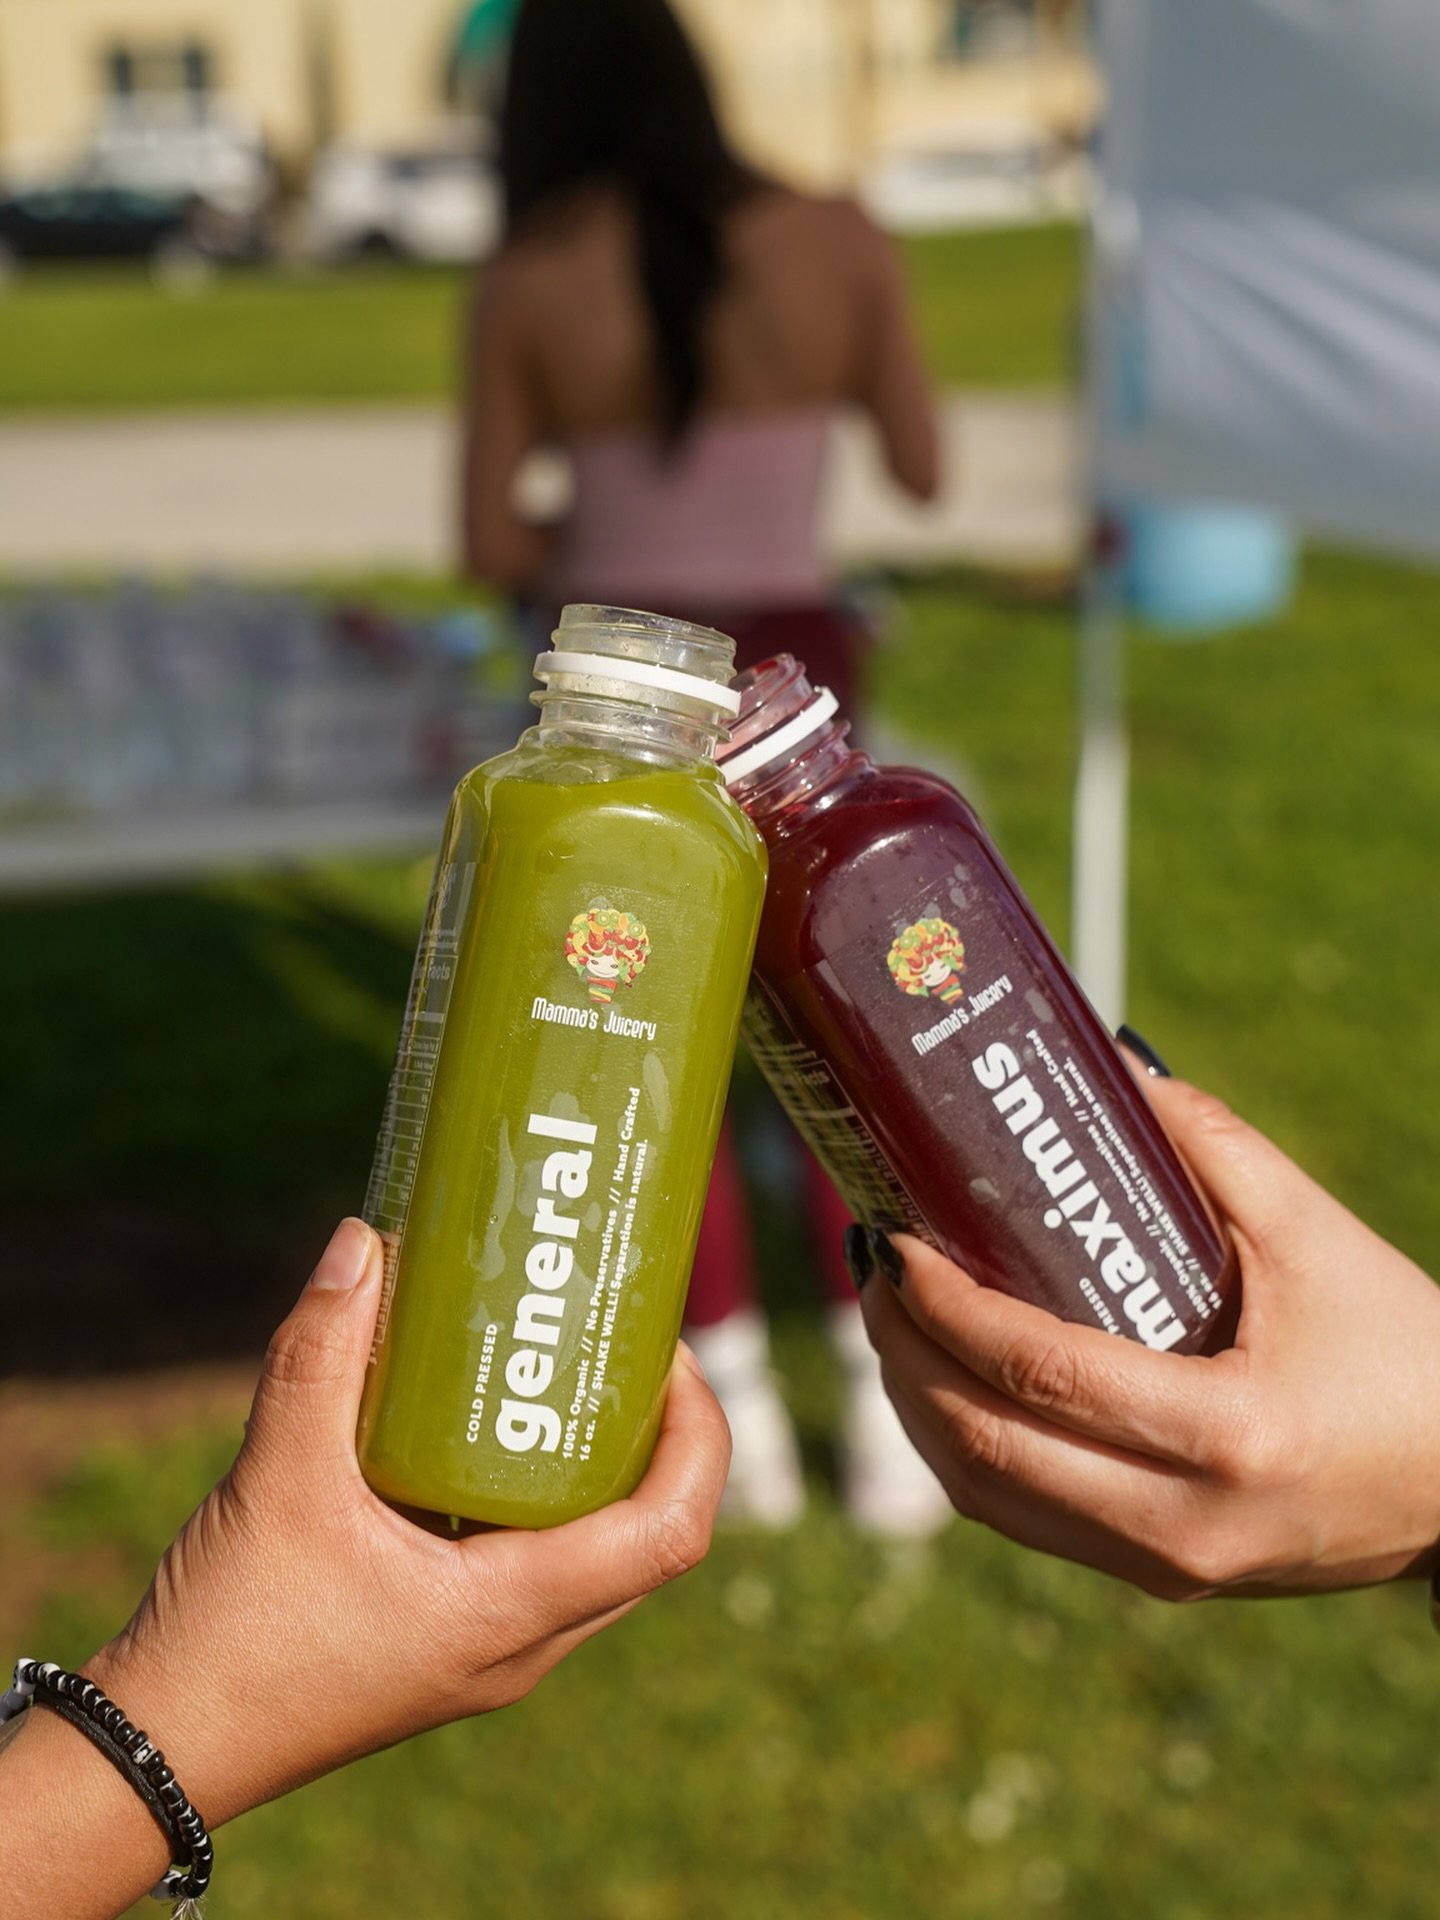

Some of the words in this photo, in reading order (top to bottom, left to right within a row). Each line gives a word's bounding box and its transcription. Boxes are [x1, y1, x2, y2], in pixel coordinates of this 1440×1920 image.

[531, 996, 599, 1030] Mamma's
[602, 1009, 657, 1041] Juicery
[911, 1007, 970, 1055] Mamma's
[967, 974, 1012, 1017] Juicery
[1025, 1028, 1059, 1075] Crafted
[1052, 1072, 1078, 1107] Hand
[620, 1086, 640, 1142] Crafted
[612, 1145, 629, 1181] Hand
[630, 1138, 648, 1193] natural.
[1087, 1123, 1139, 1203] Preservatives
[608, 1186, 621, 1204] //
[623, 1196, 637, 1210] is
[971, 1041, 1186, 1352] maximus
[1135, 1200, 1150, 1222] No
[588, 1209, 618, 1307] Preservatives
[609, 1211, 634, 1289] Separation
[1158, 1238, 1190, 1285] Organic
[495, 1113, 598, 1452] general
[1078, 1277, 1119, 1335] PRESSED
[1185, 1282, 1210, 1318] 100%
[584, 1308, 598, 1330] No
[600, 1290, 619, 1337] WELL!
[474, 1323, 498, 1393] PRESSED
[580, 1335, 593, 1353] //
[591, 1339, 610, 1391] SHAKE
[569, 1358, 590, 1415] Organic
[465, 1397, 484, 1443] COLD
[562, 1418, 578, 1458] 100%
[584, 1419, 596, 1441] oz.
[578, 1443, 591, 1461] 16
